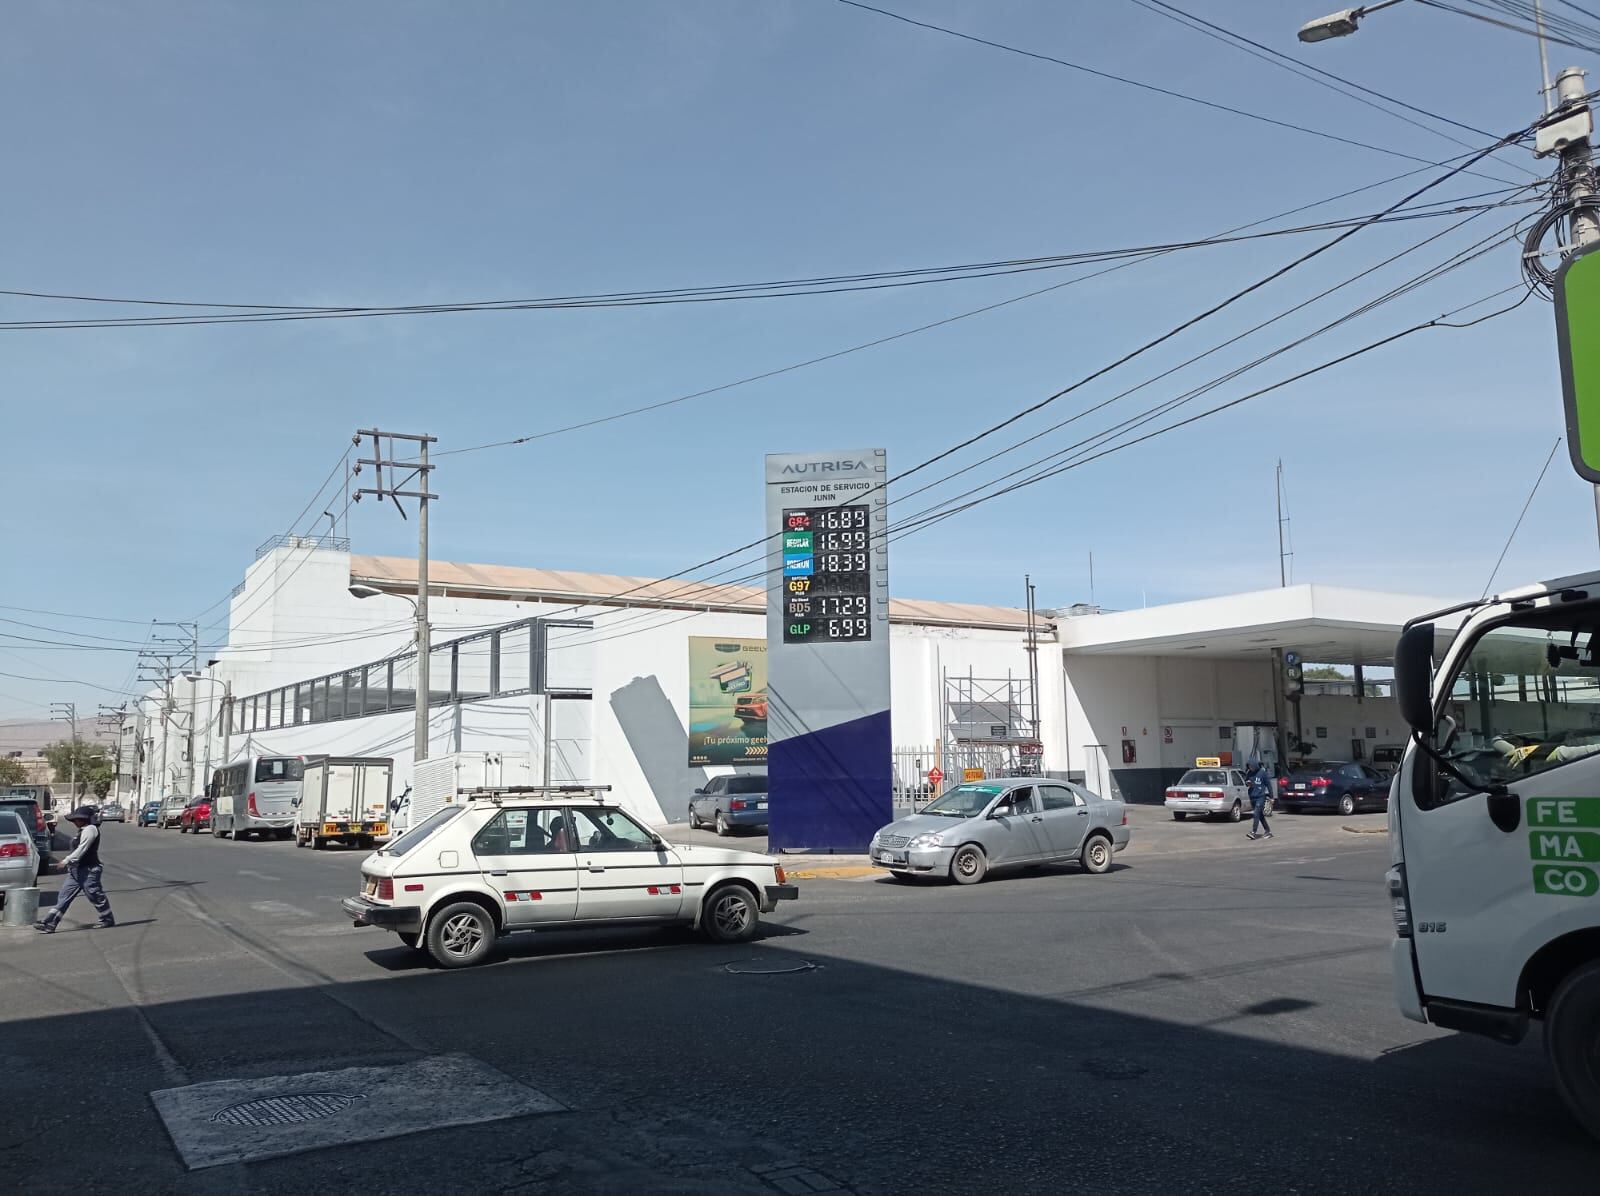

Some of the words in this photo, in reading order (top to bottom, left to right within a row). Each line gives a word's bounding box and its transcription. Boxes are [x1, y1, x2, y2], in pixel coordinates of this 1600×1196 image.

[782, 460, 868, 474] AUTRISA
[781, 486, 818, 494] ESTACION
[833, 483, 870, 491] SERVICIO
[814, 494, 836, 502] JUNIN
[788, 517, 810, 527] G84
[821, 510, 865, 529] 16.89
[821, 532, 865, 550] 16.99
[822, 553, 866, 572] 18.39
[789, 580, 811, 591] G97
[789, 602, 811, 613] BD5
[822, 597, 867, 615] 17.29
[789, 624, 811, 635] GLP
[829, 618, 867, 637] 6.99
[717, 735, 750, 746] próximo
[1537, 801, 1577, 823] FE
[1540, 835, 1584, 858] MA
[1544, 869, 1587, 892] CO
